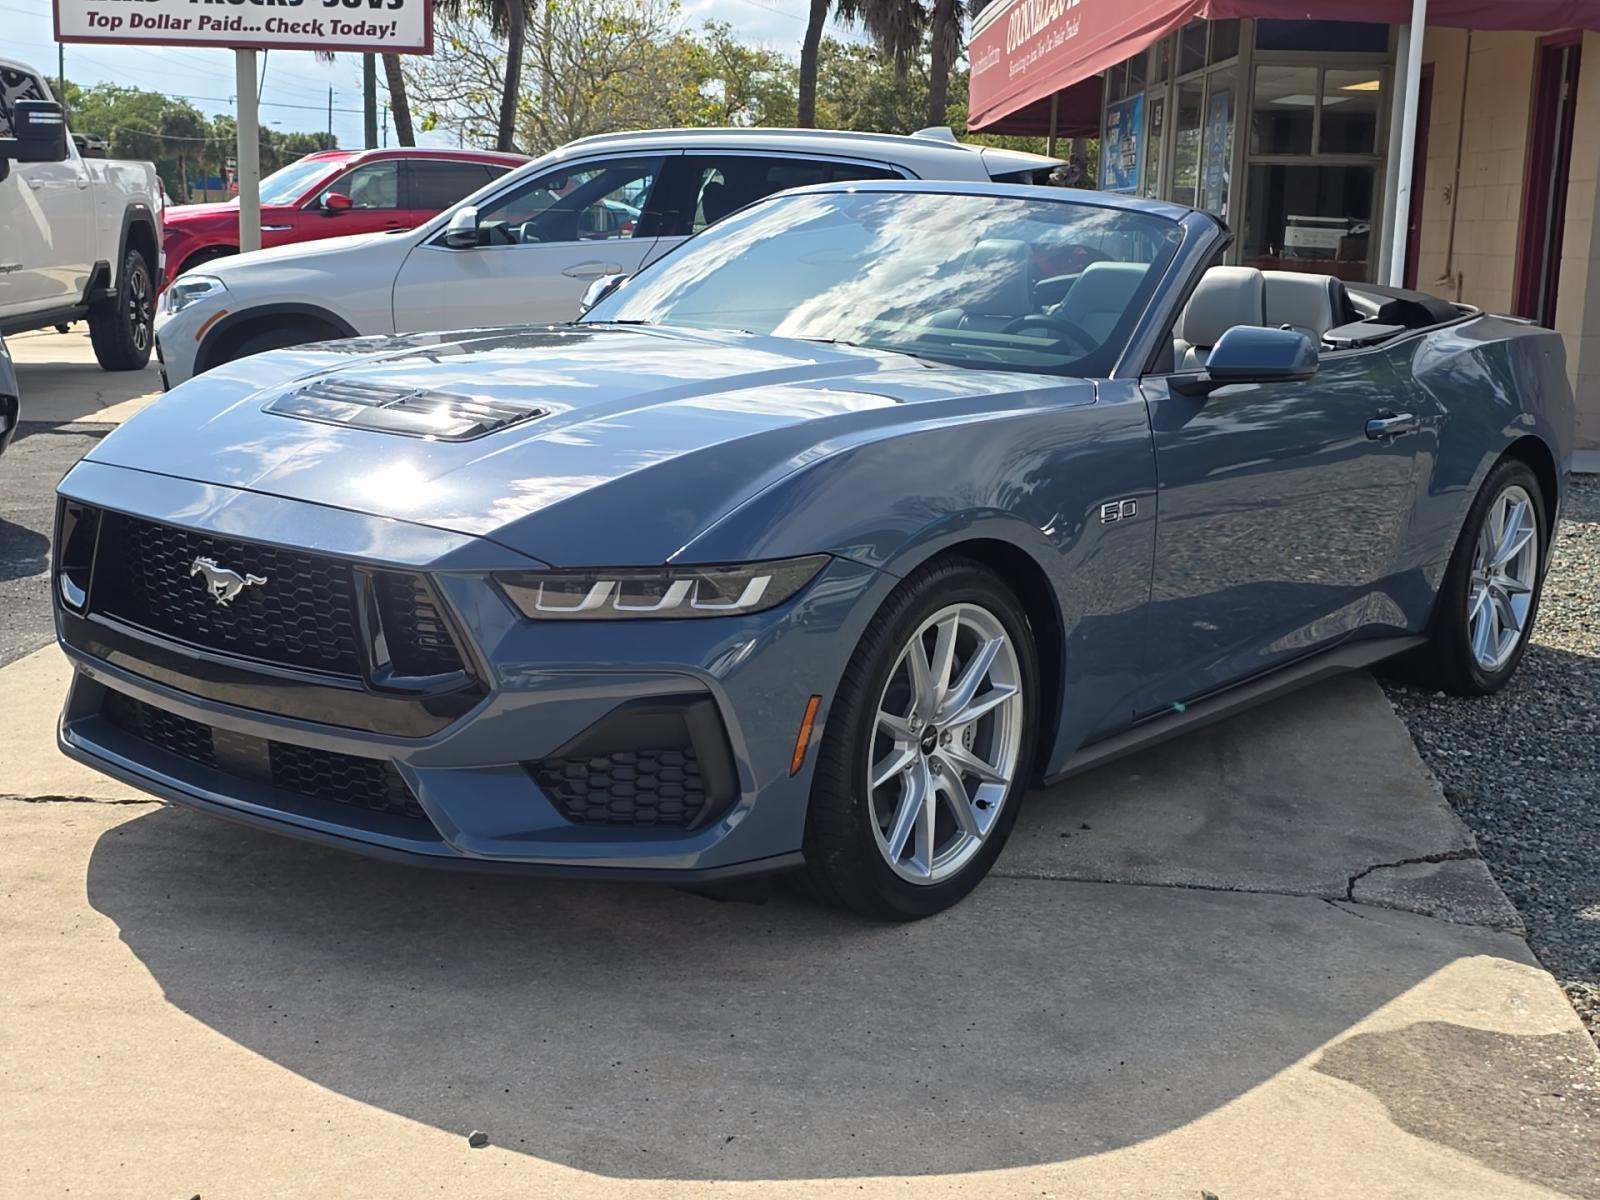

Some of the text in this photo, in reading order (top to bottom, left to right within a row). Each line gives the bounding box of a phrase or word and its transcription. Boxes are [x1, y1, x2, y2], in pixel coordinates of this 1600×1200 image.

[87, 11, 397, 39] Top Dollar Paid... Check Today!
[1100, 498, 1137, 524] 5.0
